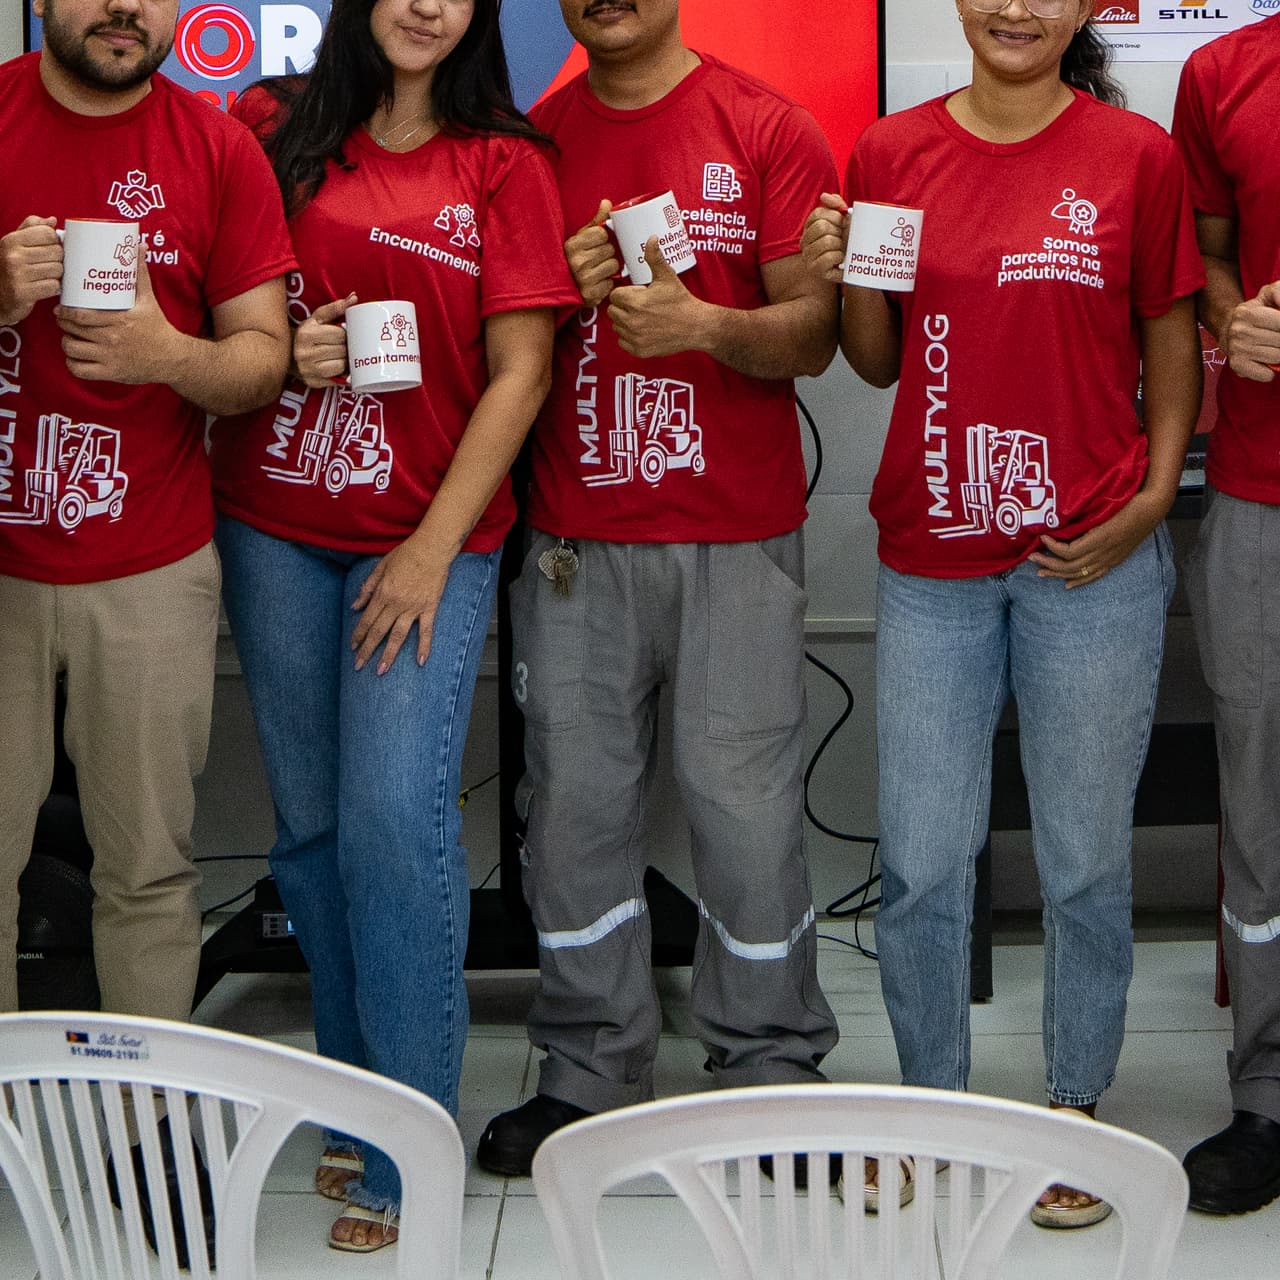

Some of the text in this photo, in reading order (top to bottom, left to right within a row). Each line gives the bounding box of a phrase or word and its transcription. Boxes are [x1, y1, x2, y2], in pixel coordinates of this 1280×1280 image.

[1094, 6, 1137, 21] Linde
[1159, 9, 1228, 19] STILL
[153, 230, 165, 246] é
[689, 223, 757, 241] melhoria
[369, 227, 481, 277] Encantamento
[690, 237, 743, 255] ontínua
[879, 244, 915, 257] Somos
[1042, 236, 1099, 256] Somos
[851, 253, 902, 268] parceiros
[1001, 250, 1101, 272] parceiros na
[88, 268, 132, 279] Caráter
[848, 264, 916, 280] produtividad
[997, 265, 1105, 290] produtividade
[576, 306, 602, 465] MULTYLO
[924, 313, 954, 518] MULTYLOG
[516, 661, 528, 703] 3
